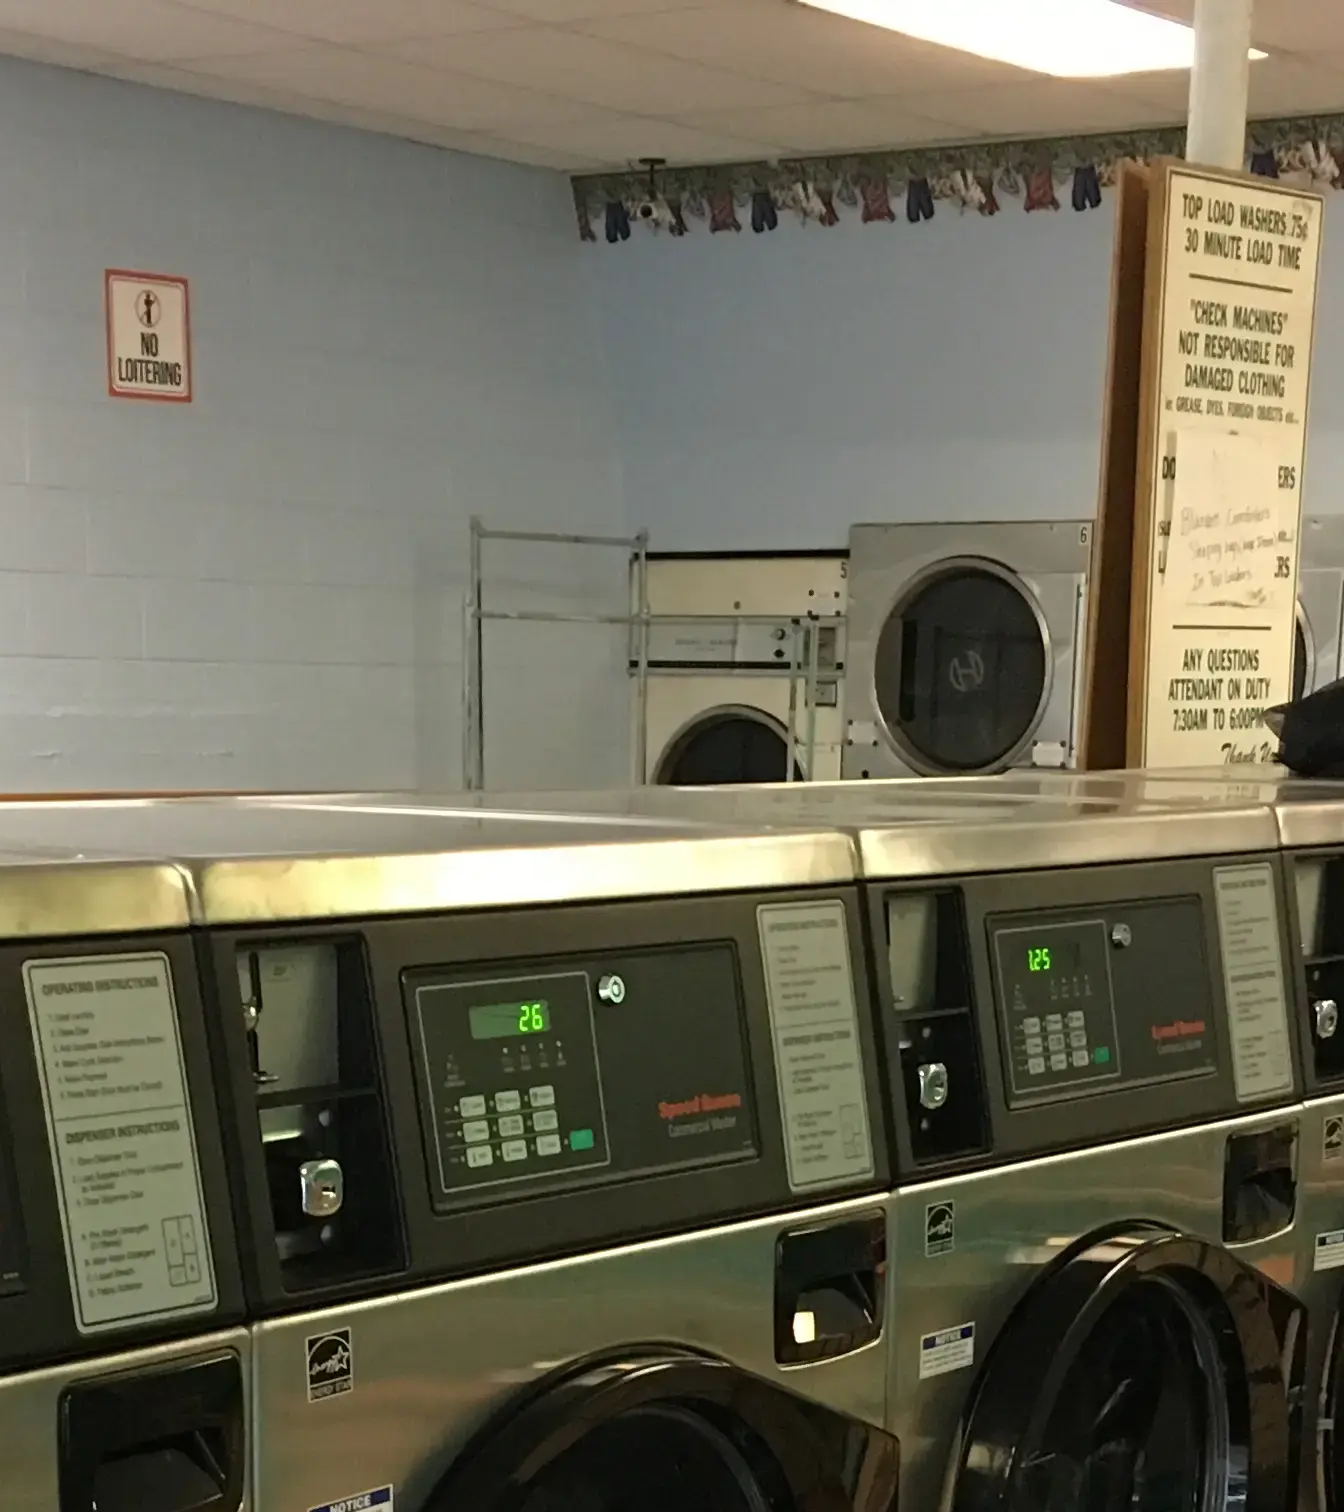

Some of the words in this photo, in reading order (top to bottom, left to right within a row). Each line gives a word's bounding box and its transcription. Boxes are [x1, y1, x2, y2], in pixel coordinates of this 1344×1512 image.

[1182, 193, 1203, 220] TOP
[1207, 198, 1235, 226] LOAD
[1240, 204, 1287, 236] WASHERS
[1184, 227, 1199, 253] 30
[1204, 230, 1243, 260] MINUTE
[1246, 237, 1273, 265] LOAD
[1278, 244, 1302, 270] TIME
[1190, 298, 1228, 328] "CHECK
[1232, 305, 1289, 336] MACHINES"
[140, 331, 159, 357] NO
[1178, 329, 1200, 356] NOT
[1204, 333, 1272, 365] RESPONSIBLE
[1274, 343, 1295, 368] FOR
[117, 357, 182, 386] LOITERING
[1184, 363, 1234, 392] DAMAGED
[1238, 371, 1286, 398] CLOTHING
[1080, 526, 1087, 544] 6
[840, 560, 847, 579] 5
[1182, 648, 1203, 672] ANY
[1207, 648, 1260, 674] QUESTIONS
[1168, 678, 1224, 701] ATTENDANT
[1227, 677, 1241, 701] ON
[1245, 677, 1271, 701] DUTY
[1172, 708, 1208, 731] 7:30AM
[1213, 707, 1225, 730] TO
[1230, 706, 1265, 729] 6:00PM
[1221, 742, 1256, 765] Thank
[519, 1003, 543, 1032] 26
